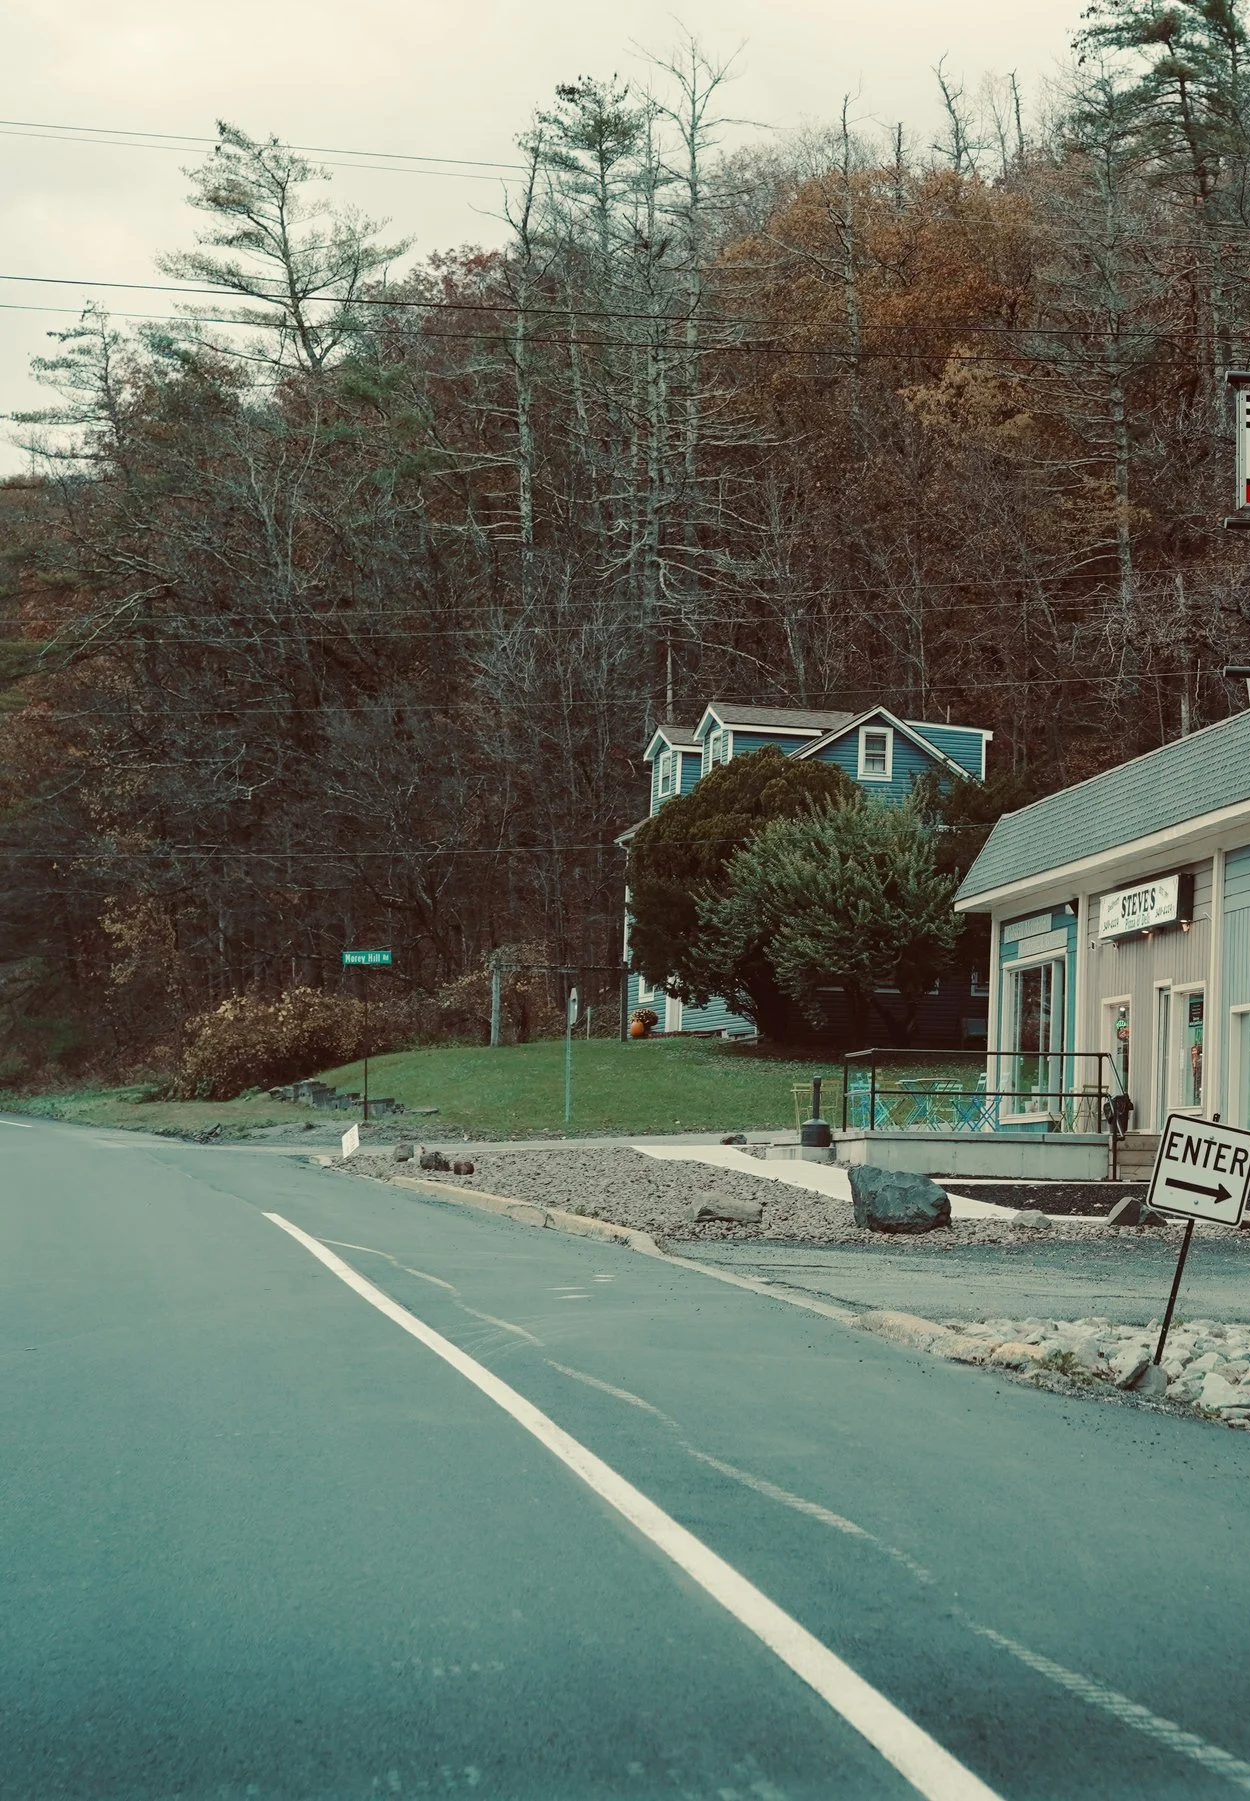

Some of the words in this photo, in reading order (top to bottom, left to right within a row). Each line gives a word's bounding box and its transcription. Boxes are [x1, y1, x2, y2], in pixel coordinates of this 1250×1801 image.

[345, 953, 366, 964] Morey
[368, 953, 381, 962] Hill
[1165, 1131, 1249, 1177] ENTER
